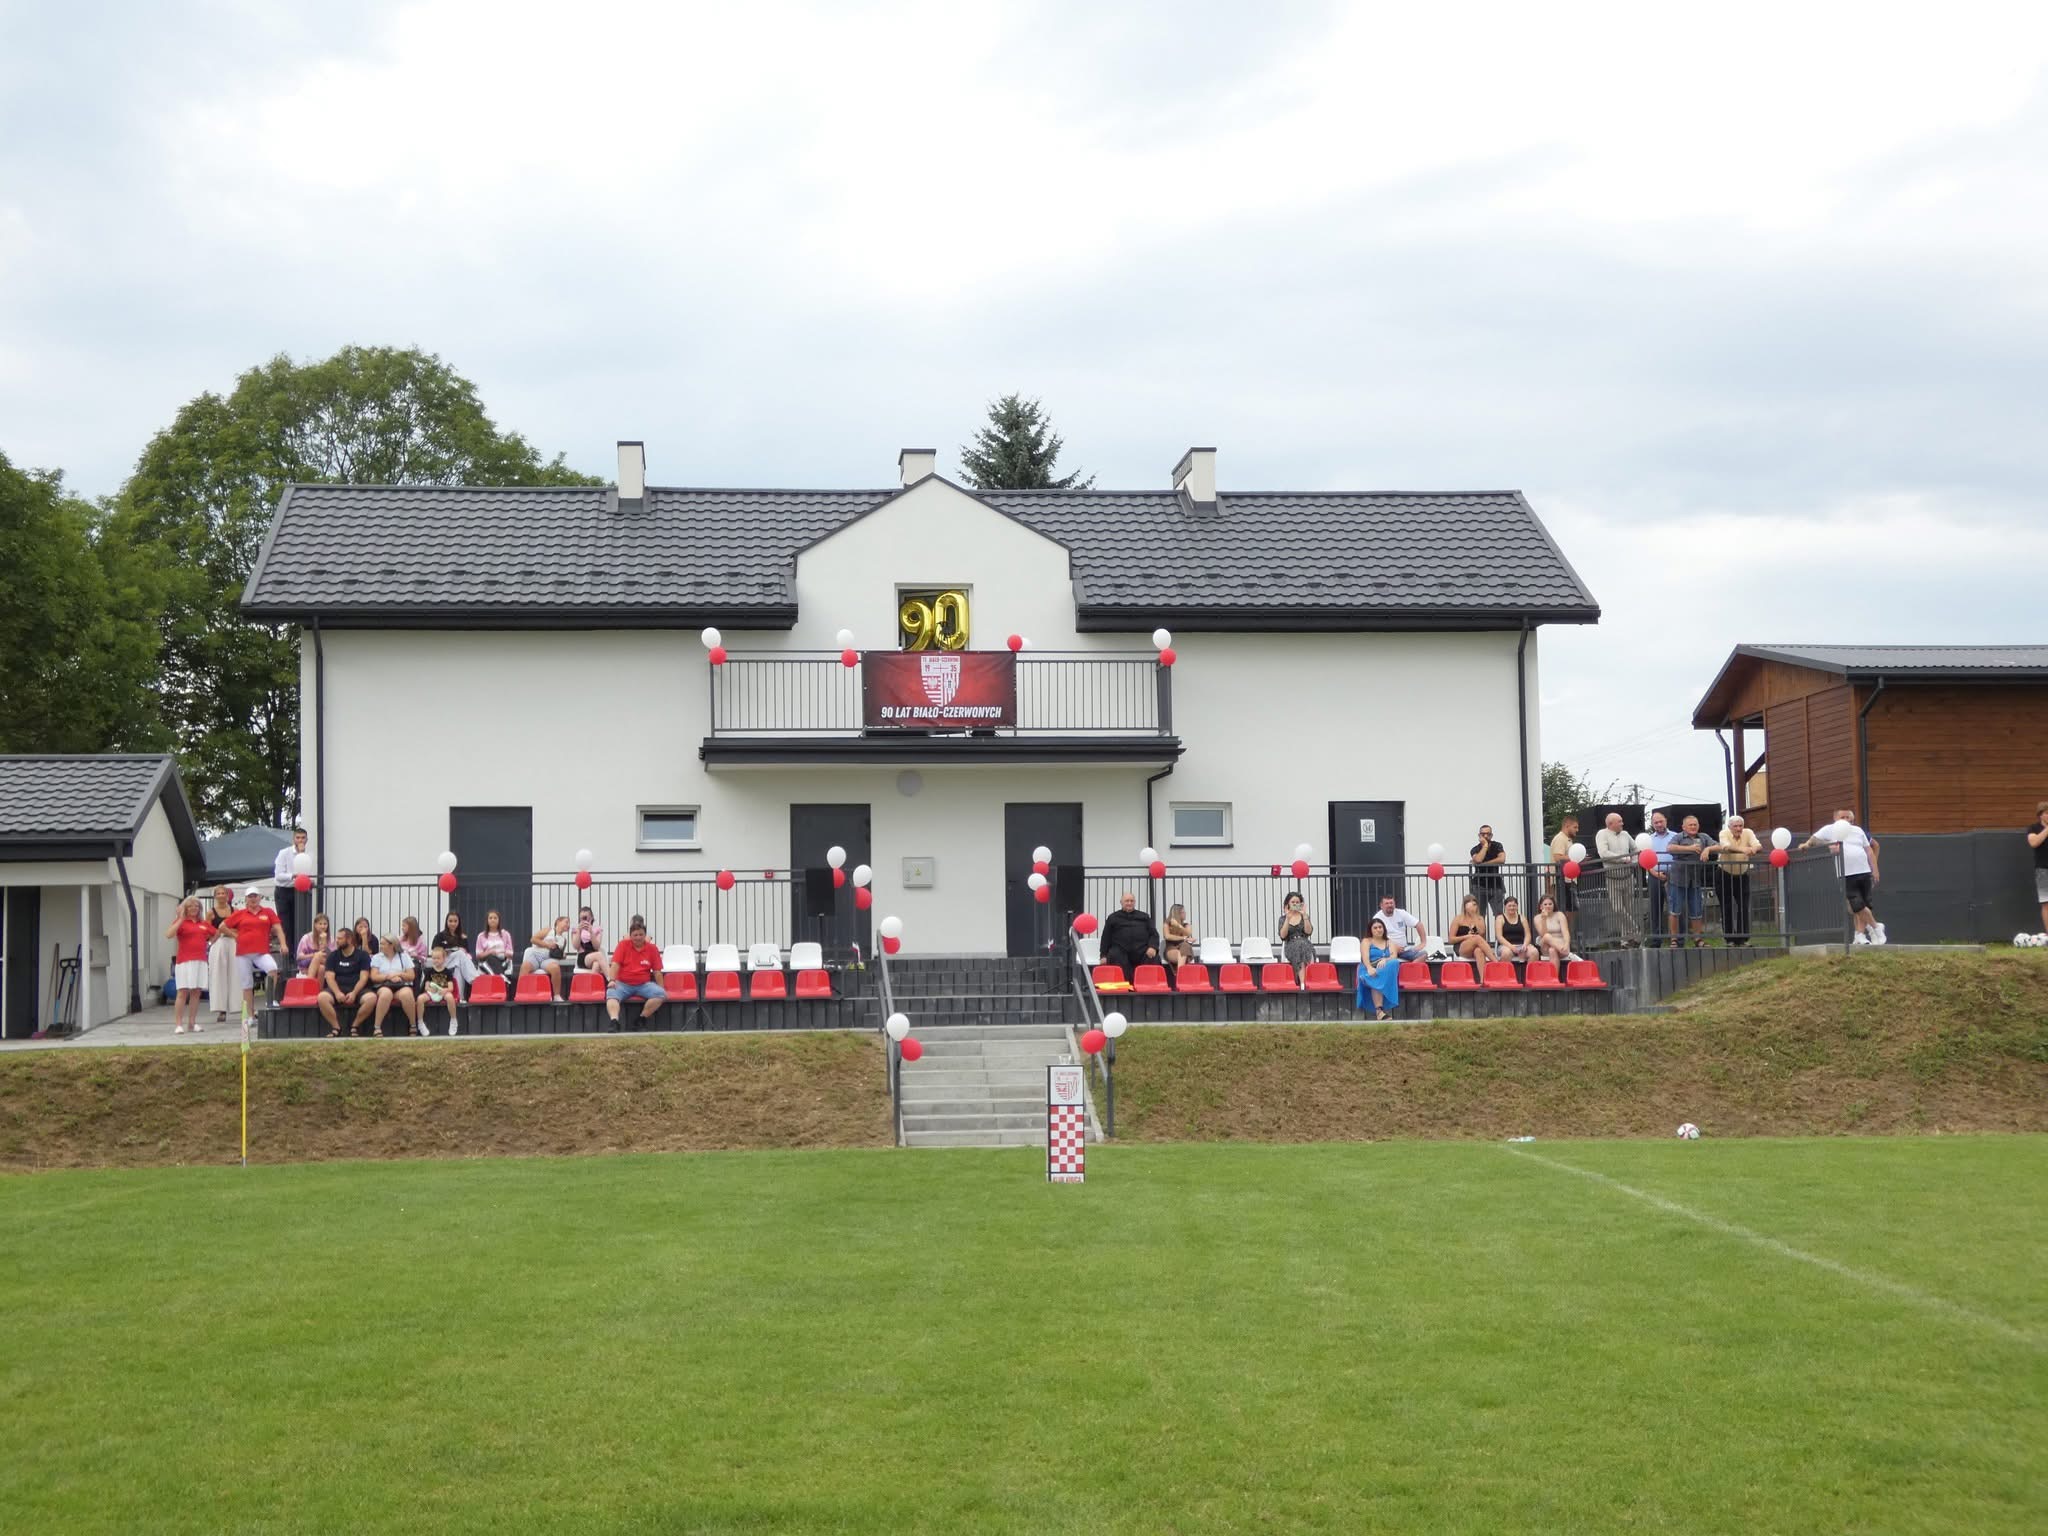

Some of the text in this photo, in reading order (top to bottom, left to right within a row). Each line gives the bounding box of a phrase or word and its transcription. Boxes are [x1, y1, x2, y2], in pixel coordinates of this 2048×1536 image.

[900, 590, 970, 651] 90
[881, 706, 1002, 718] 90 LAT BIAŁO-CZERWONYCH
